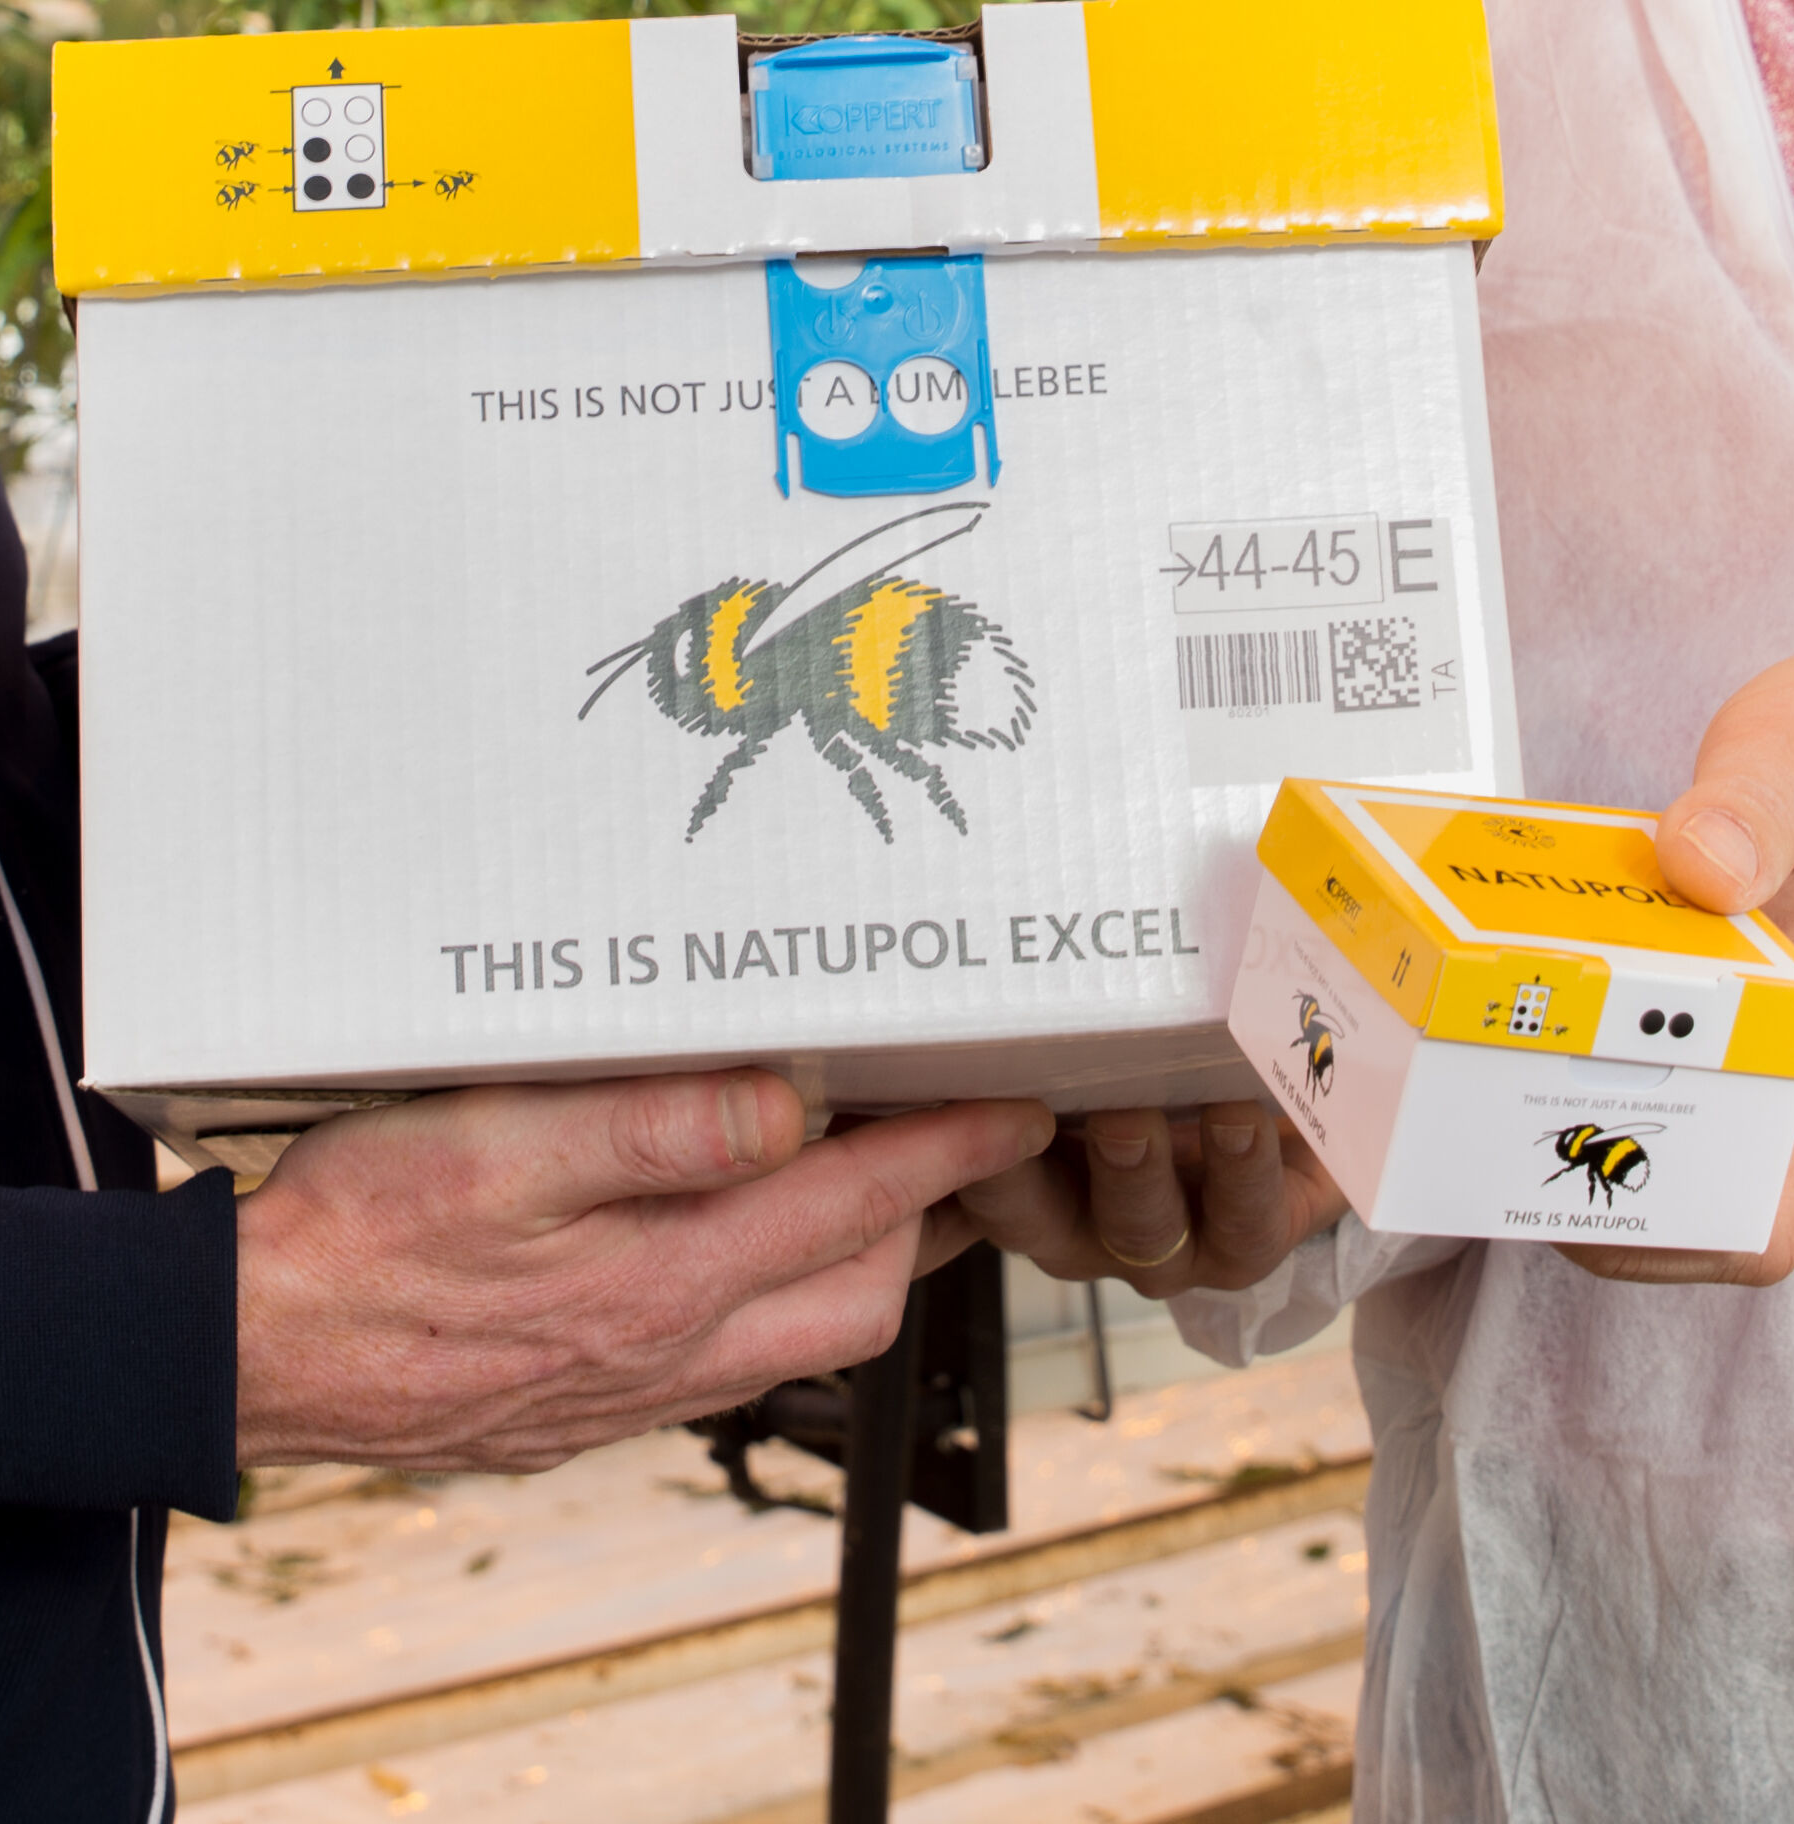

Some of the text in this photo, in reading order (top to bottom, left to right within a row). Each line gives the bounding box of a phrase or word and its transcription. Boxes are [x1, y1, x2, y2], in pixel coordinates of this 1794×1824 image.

[784, 95, 944, 137] KOPPERT
[777, 142, 950, 161] BIOLOGICAL SYSTEMS
[470, 388, 560, 422] THIS
[574, 386, 605, 419] IS
[620, 382, 706, 416] NOT
[824, 374, 855, 408] A
[870, 363, 1108, 406] UMLEBEE
[1196, 518, 1439, 594] 44-45 E
[1430, 658, 1457, 701] TA
[1447, 863, 1689, 909] NATUPOL
[440, 907, 1200, 995] THIS IS NATUPOL EXCEL
[1271, 1059, 1288, 1092] THIS
[1294, 1090, 1327, 1147] NATUPOL
[1522, 1093, 1697, 1116] THIS IS NOT JUST A BUMBLEBEE
[1504, 1209, 1649, 1232] THIS IS NATUPOL
